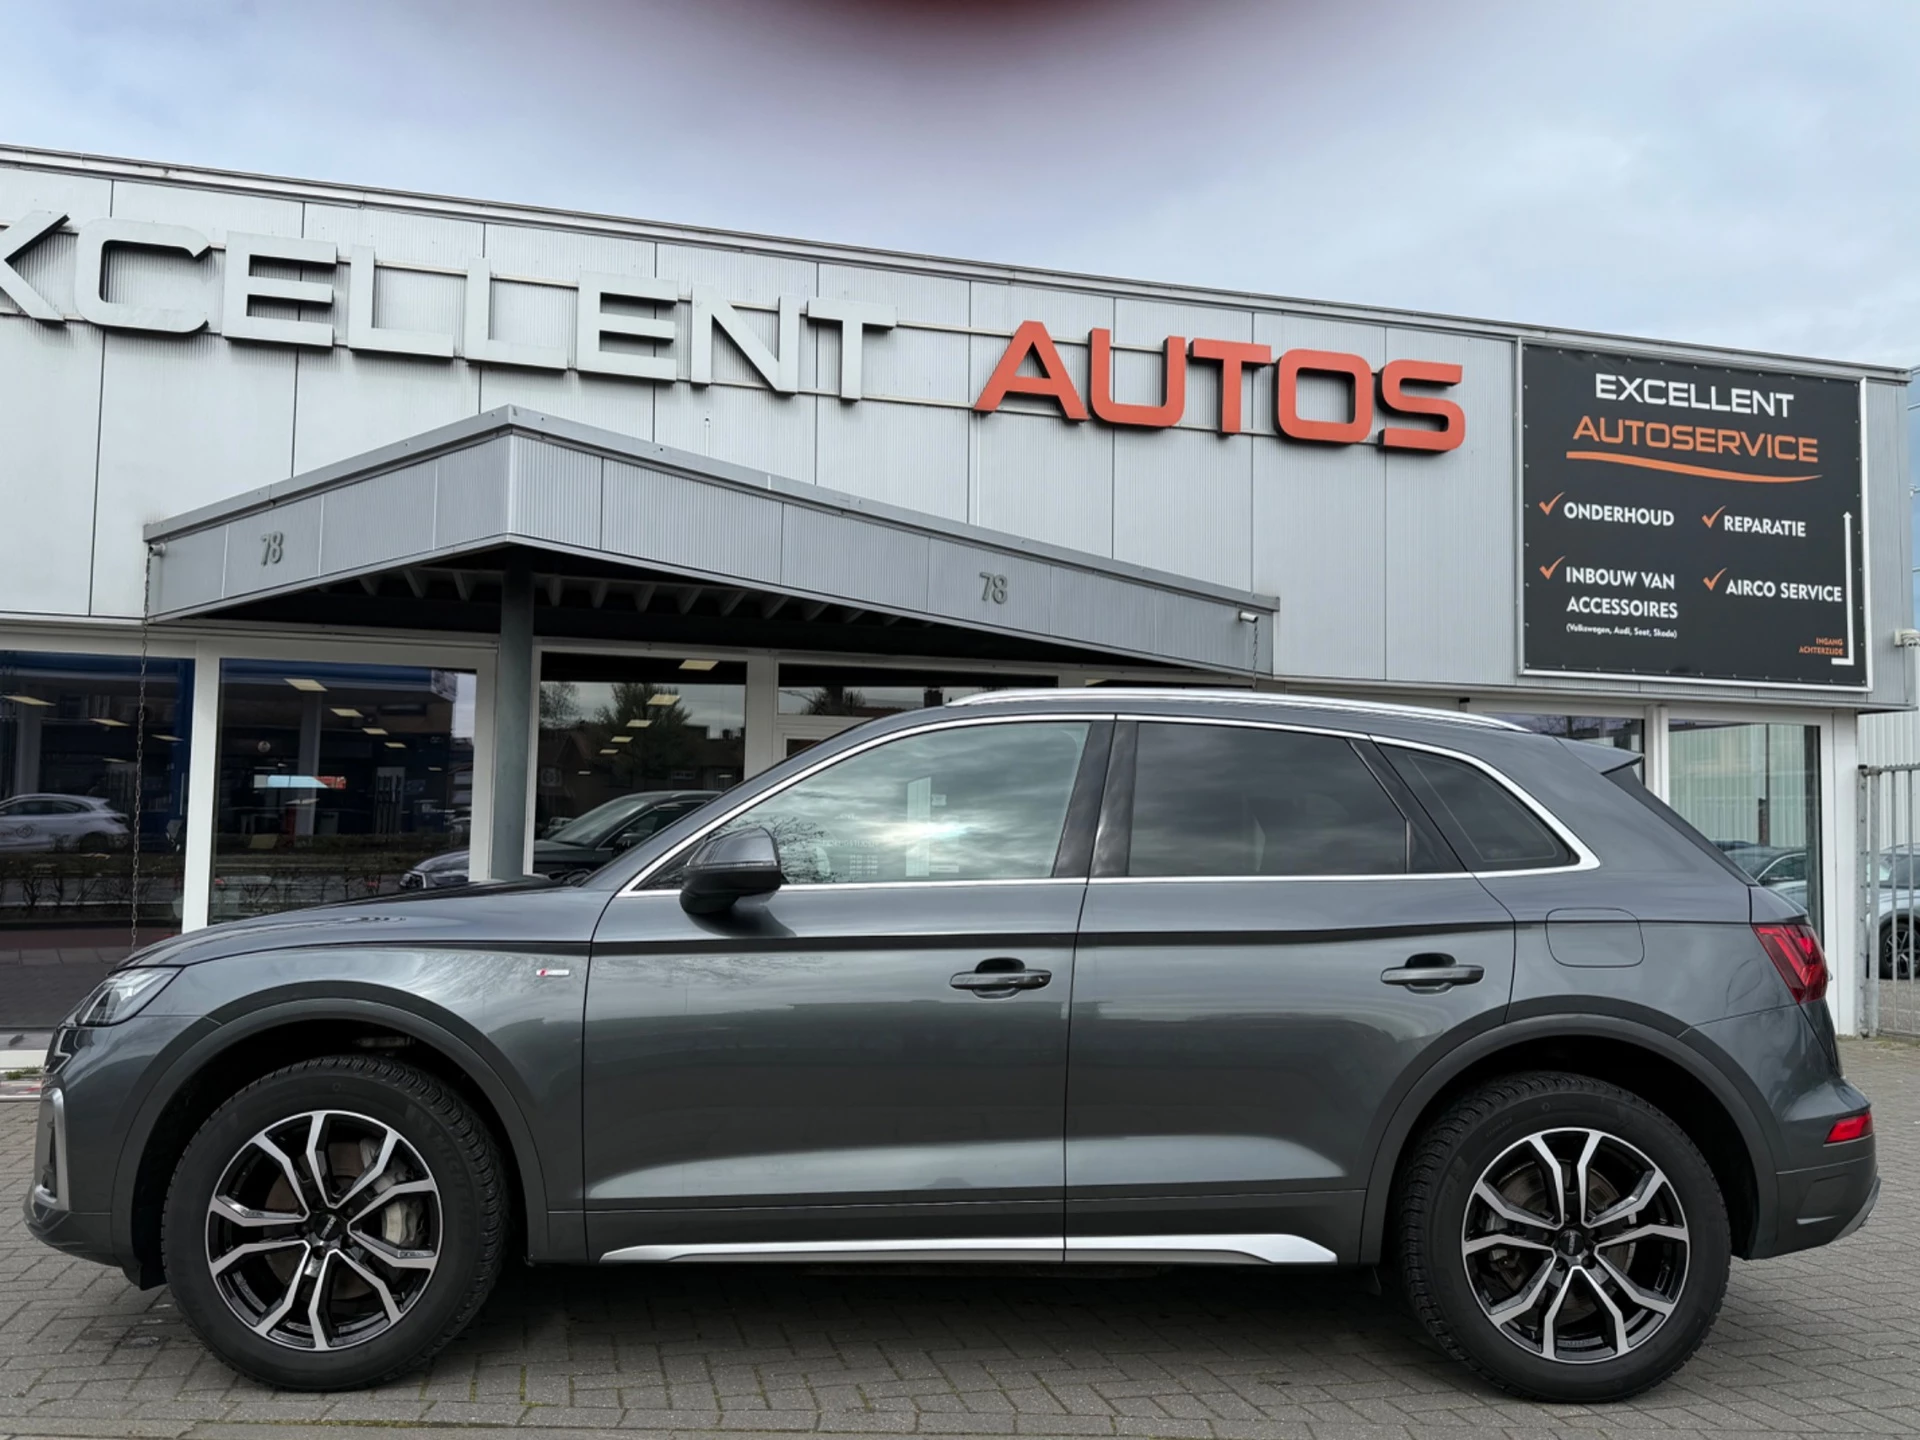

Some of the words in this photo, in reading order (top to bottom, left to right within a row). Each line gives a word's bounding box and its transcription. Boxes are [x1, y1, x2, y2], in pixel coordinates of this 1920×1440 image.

[973, 319, 1465, 452] AUTOS
[1595, 373, 1794, 418] EXCELLENT
[1572, 415, 1819, 463] AUTOSERVICE
[1563, 501, 1675, 527] ONDERHOUD
[1723, 515, 1807, 537] REPARATIE
[260, 531, 284, 567] 78
[979, 571, 1008, 605] 78
[1566, 566, 1637, 588] INBOUW
[1640, 571, 1675, 590] VAN
[1725, 579, 1776, 598] AIRCO
[1780, 582, 1843, 602] SERVICE
[1566, 596, 1679, 620] ACCESSOIRES
[1566, 623, 1612, 636] (Volkswagen,
[1613, 625, 1633, 637] Audi,
[1634, 627, 1652, 638] Seat,
[1815, 637, 1844, 647] INGANG
[1798, 645, 1844, 656] ACHTERZIJDE
